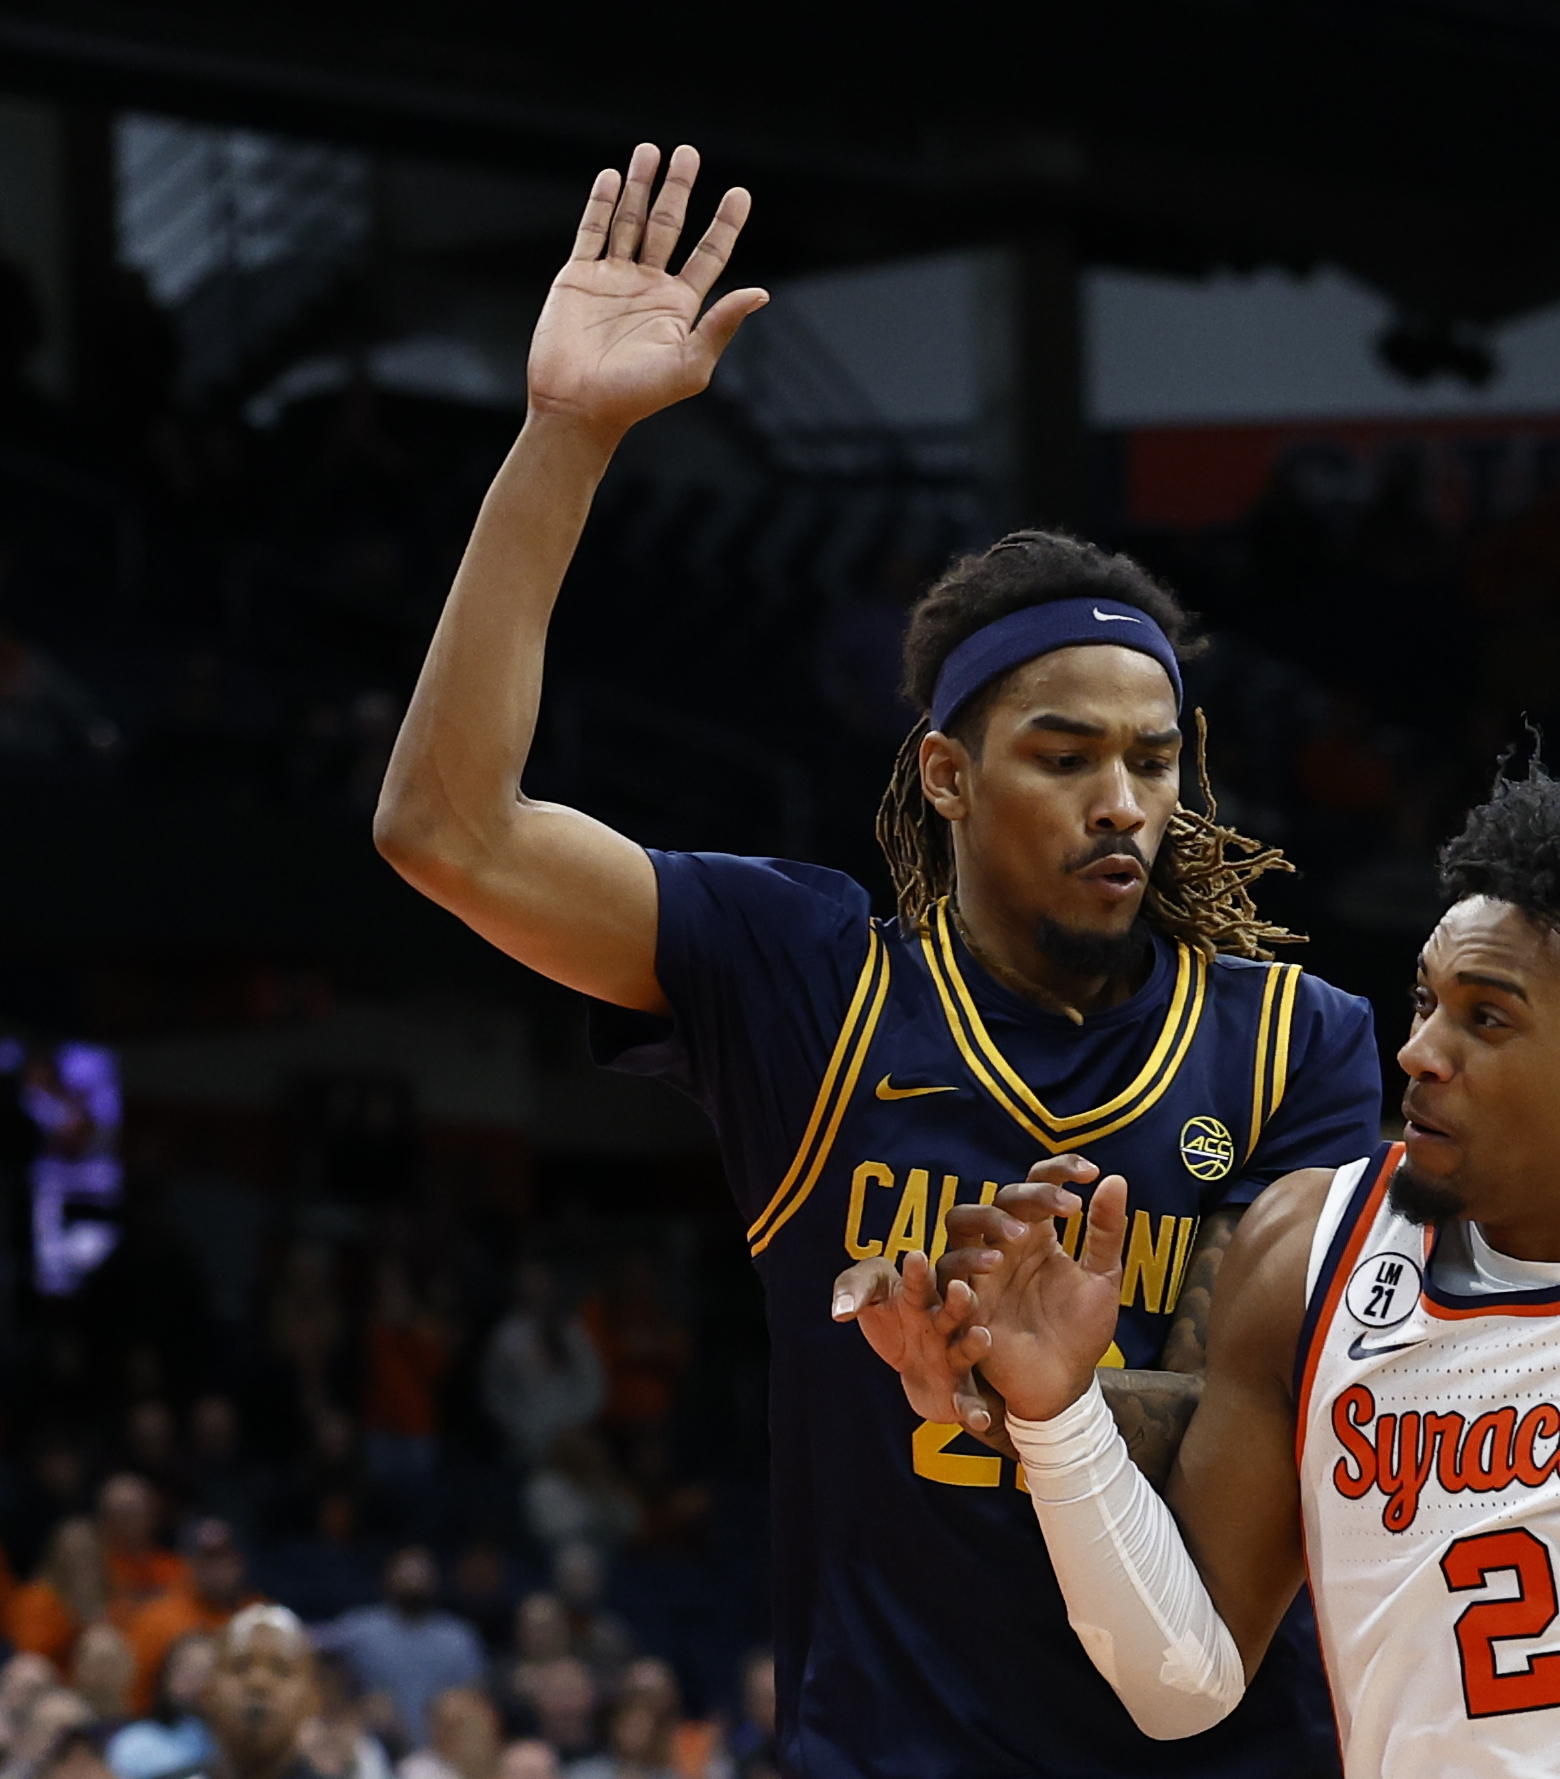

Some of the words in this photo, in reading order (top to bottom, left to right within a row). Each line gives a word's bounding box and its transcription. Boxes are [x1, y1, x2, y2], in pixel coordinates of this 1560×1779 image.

[1185, 1135, 1233, 1157] ACC
[1375, 1261, 1404, 1286] LM
[1363, 1285, 1395, 1319] 21
